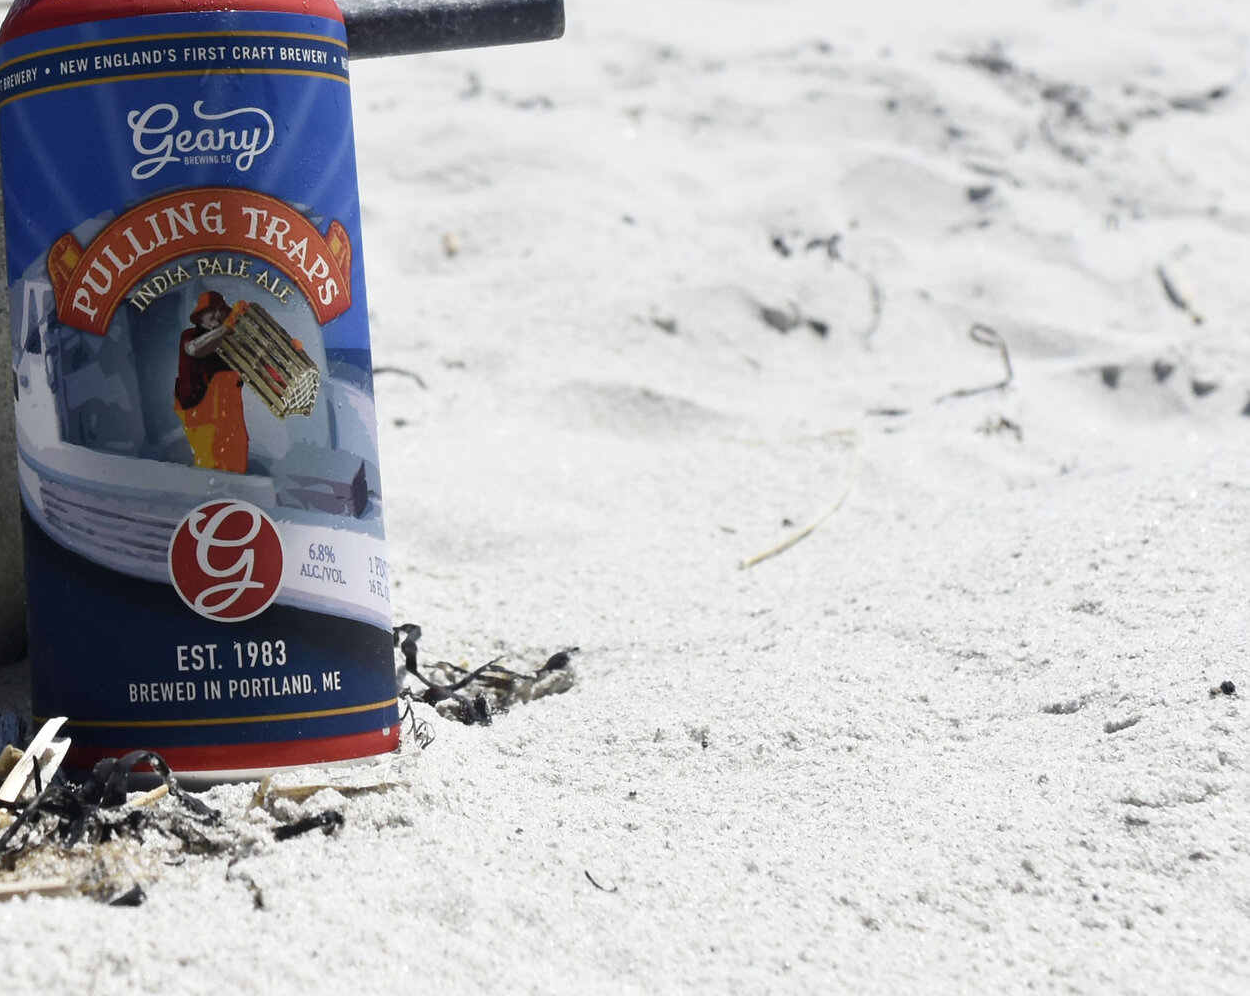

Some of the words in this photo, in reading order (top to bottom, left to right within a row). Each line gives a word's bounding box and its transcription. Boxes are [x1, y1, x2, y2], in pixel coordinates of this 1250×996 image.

[3, 66, 38, 91] BREWERY
[59, 57, 88, 76] NEW
[94, 48, 177, 71] ENGLAND'S
[184, 46, 226, 62] FIRST
[232, 46, 275, 61] CRAFT
[279, 46, 328, 65] BREWERY
[127, 100, 275, 180] Geary
[184, 154, 219, 166] BREWING
[72, 200, 227, 323] PULLING
[241, 206, 342, 306] TRAPS
[129, 263, 192, 313] INDIA
[196, 256, 253, 280] PALE
[256, 269, 295, 304] ALE
[308, 543, 336, 564] 6.8%
[176, 644, 223, 672] EST.
[233, 640, 287, 669] 1983
[129, 681, 197, 703] BREWED
[204, 680, 221, 700] IN
[228, 674, 317, 699] PORTLAND,
[322, 671, 341, 692] ME
